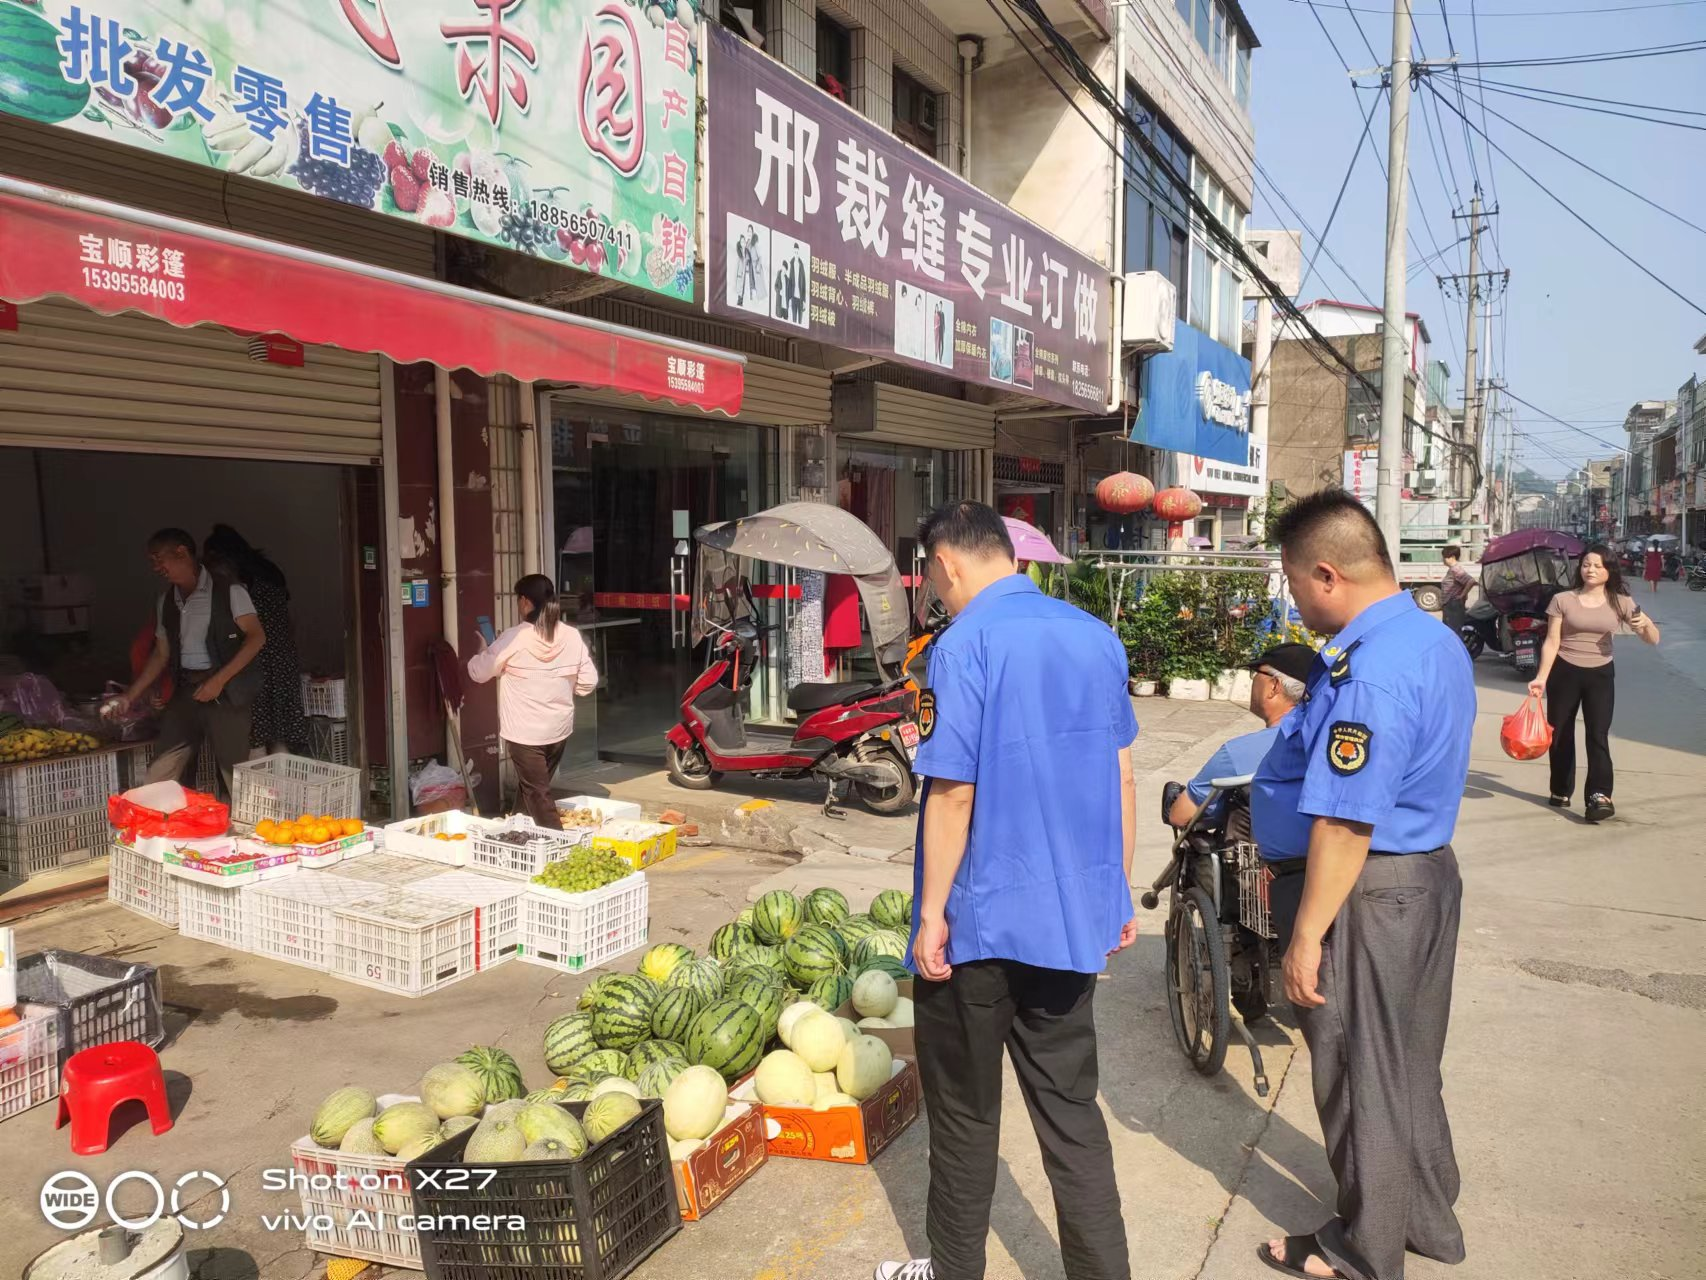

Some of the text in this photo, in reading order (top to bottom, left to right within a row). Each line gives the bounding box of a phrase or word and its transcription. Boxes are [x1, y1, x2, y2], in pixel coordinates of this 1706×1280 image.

[60, 5, 352, 166] 批发零售
[661, 17, 689, 269] 自产自销
[530, 200, 632, 249] 18856507411
[754, 88, 1098, 346] 邢裁缝专业订做
[79, 233, 186, 279] 宝顺彩篷
[82, 266, 185, 302] 15395584003
[667, 355, 705, 381] 宝顺彩篷
